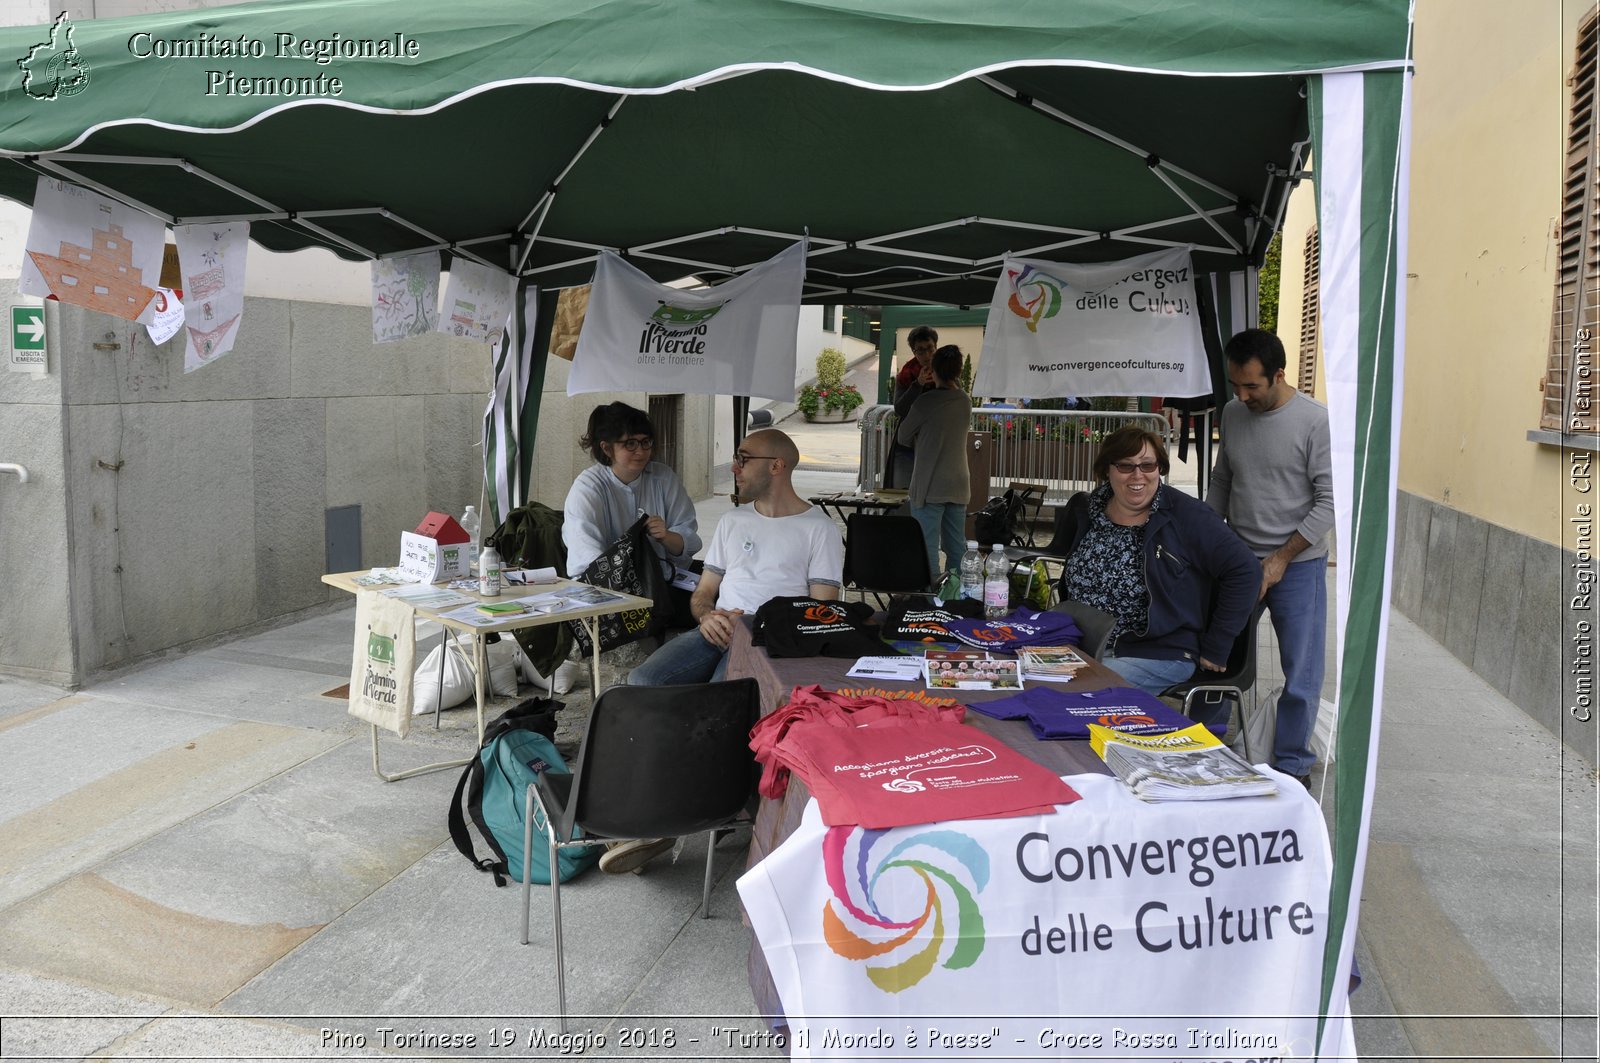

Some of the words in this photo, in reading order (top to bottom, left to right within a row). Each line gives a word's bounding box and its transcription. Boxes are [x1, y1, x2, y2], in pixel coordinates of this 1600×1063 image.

[1076, 294, 1119, 311] delle
[652, 334, 706, 355] Verde
[637, 354, 656, 365] oltre
[658, 354, 666, 365] le
[668, 354, 705, 366] frontiere
[368, 669, 397, 690] Pulmino
[368, 685, 397, 705] Verde
[859, 763, 923, 779] spargiamo
[1016, 828, 1304, 887] Convergenza
[1021, 913, 1113, 956] delle
[1135, 896, 1315, 953] Culture
